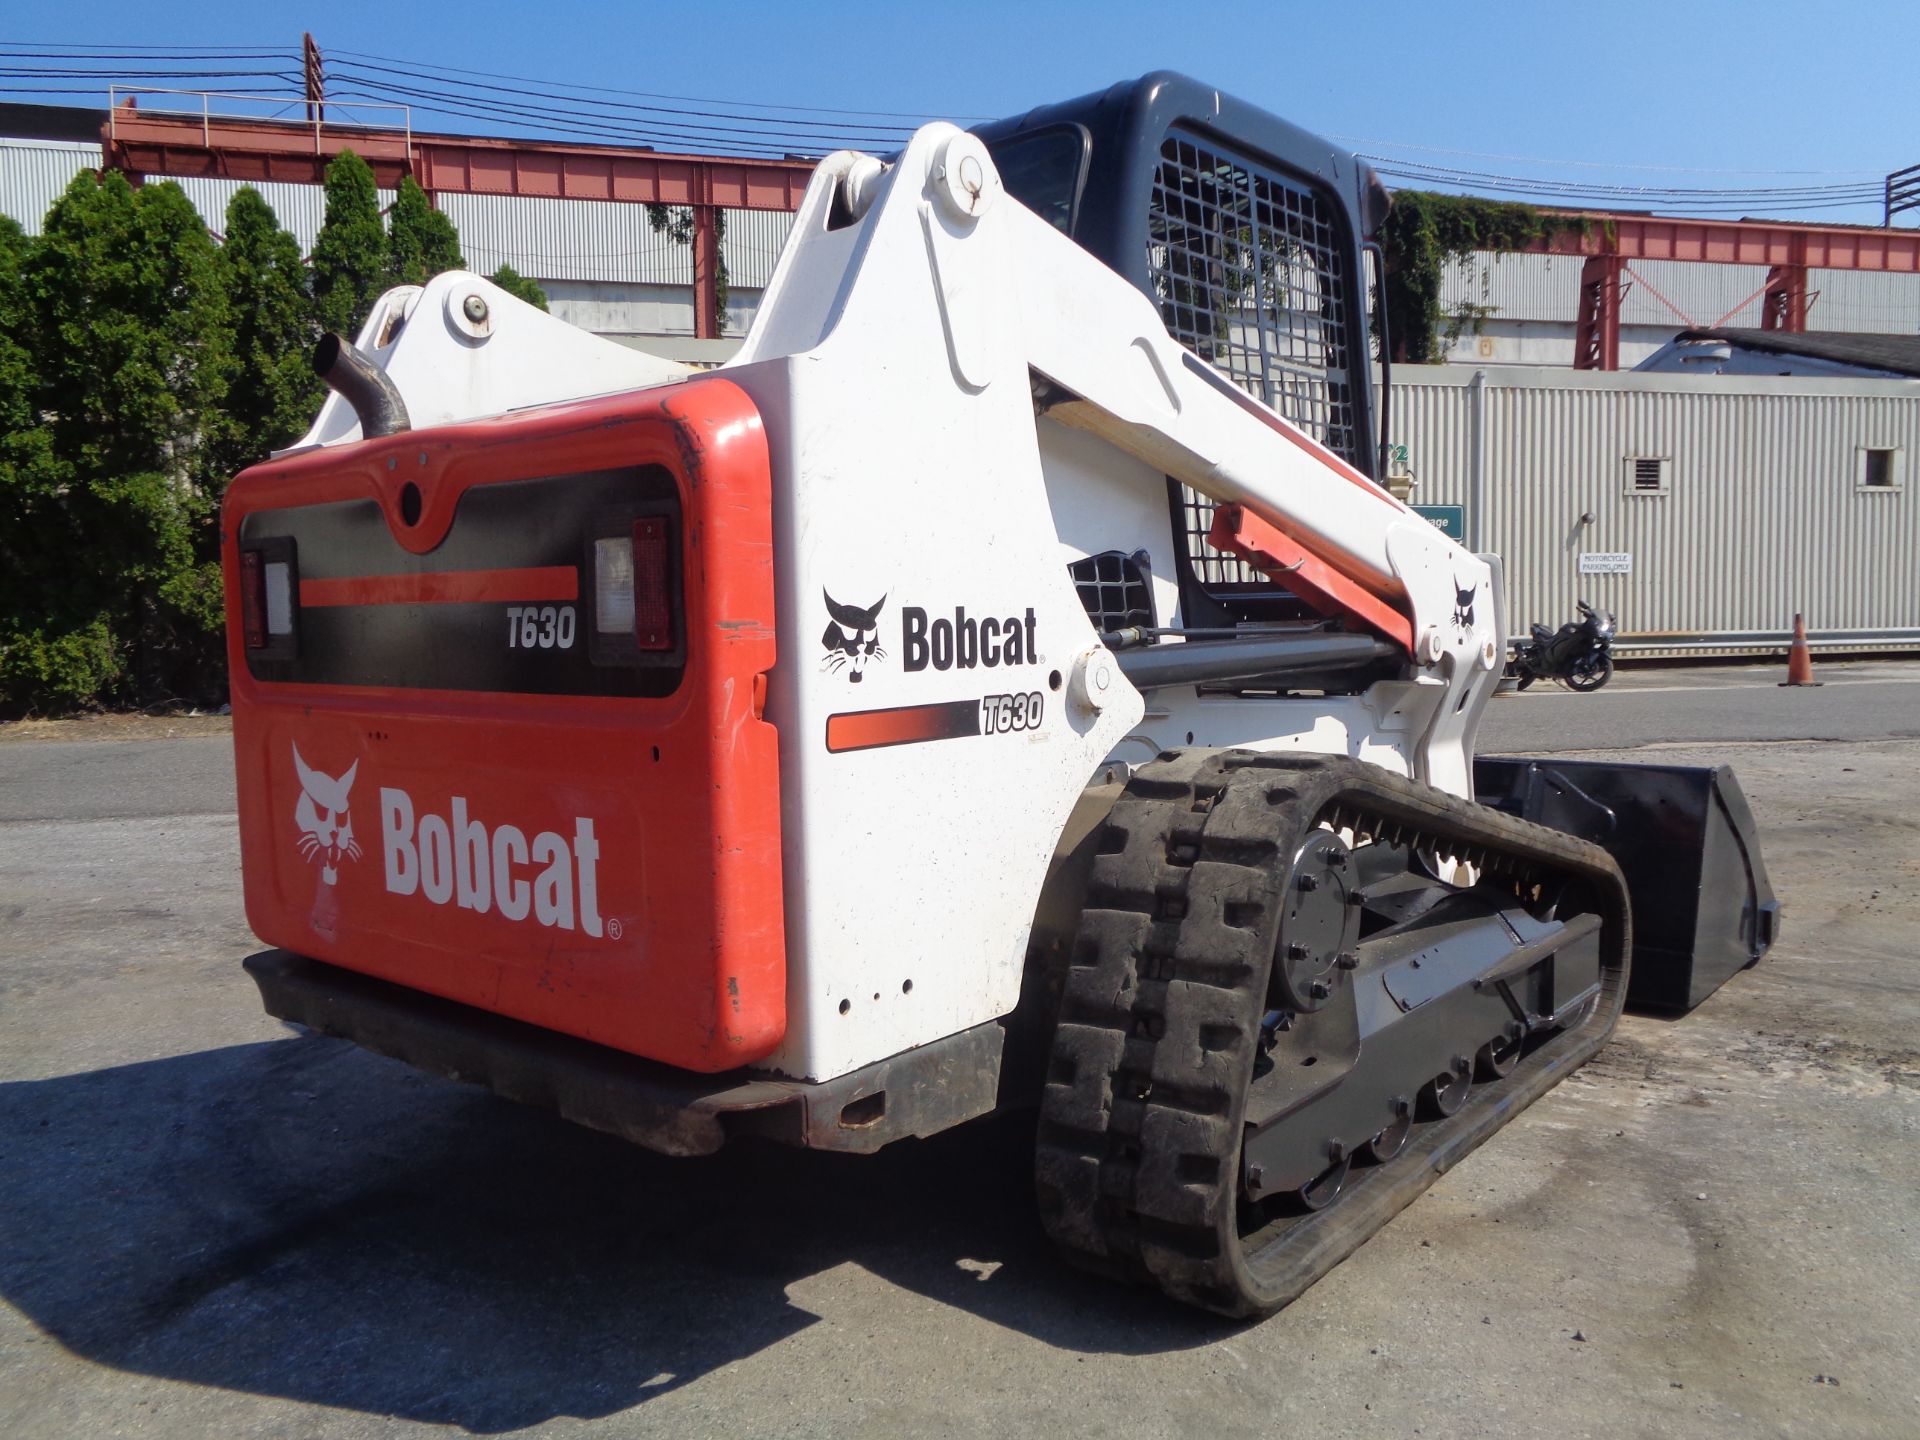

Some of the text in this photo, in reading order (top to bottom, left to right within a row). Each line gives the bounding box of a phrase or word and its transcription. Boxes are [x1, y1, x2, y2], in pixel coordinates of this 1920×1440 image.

[1582, 563, 1630, 571] PARKING ONLY
[505, 606, 576, 650] T630
[902, 606, 1038, 673] Bobcat
[982, 691, 1044, 735] T630
[379, 786, 604, 939] Bobcat
